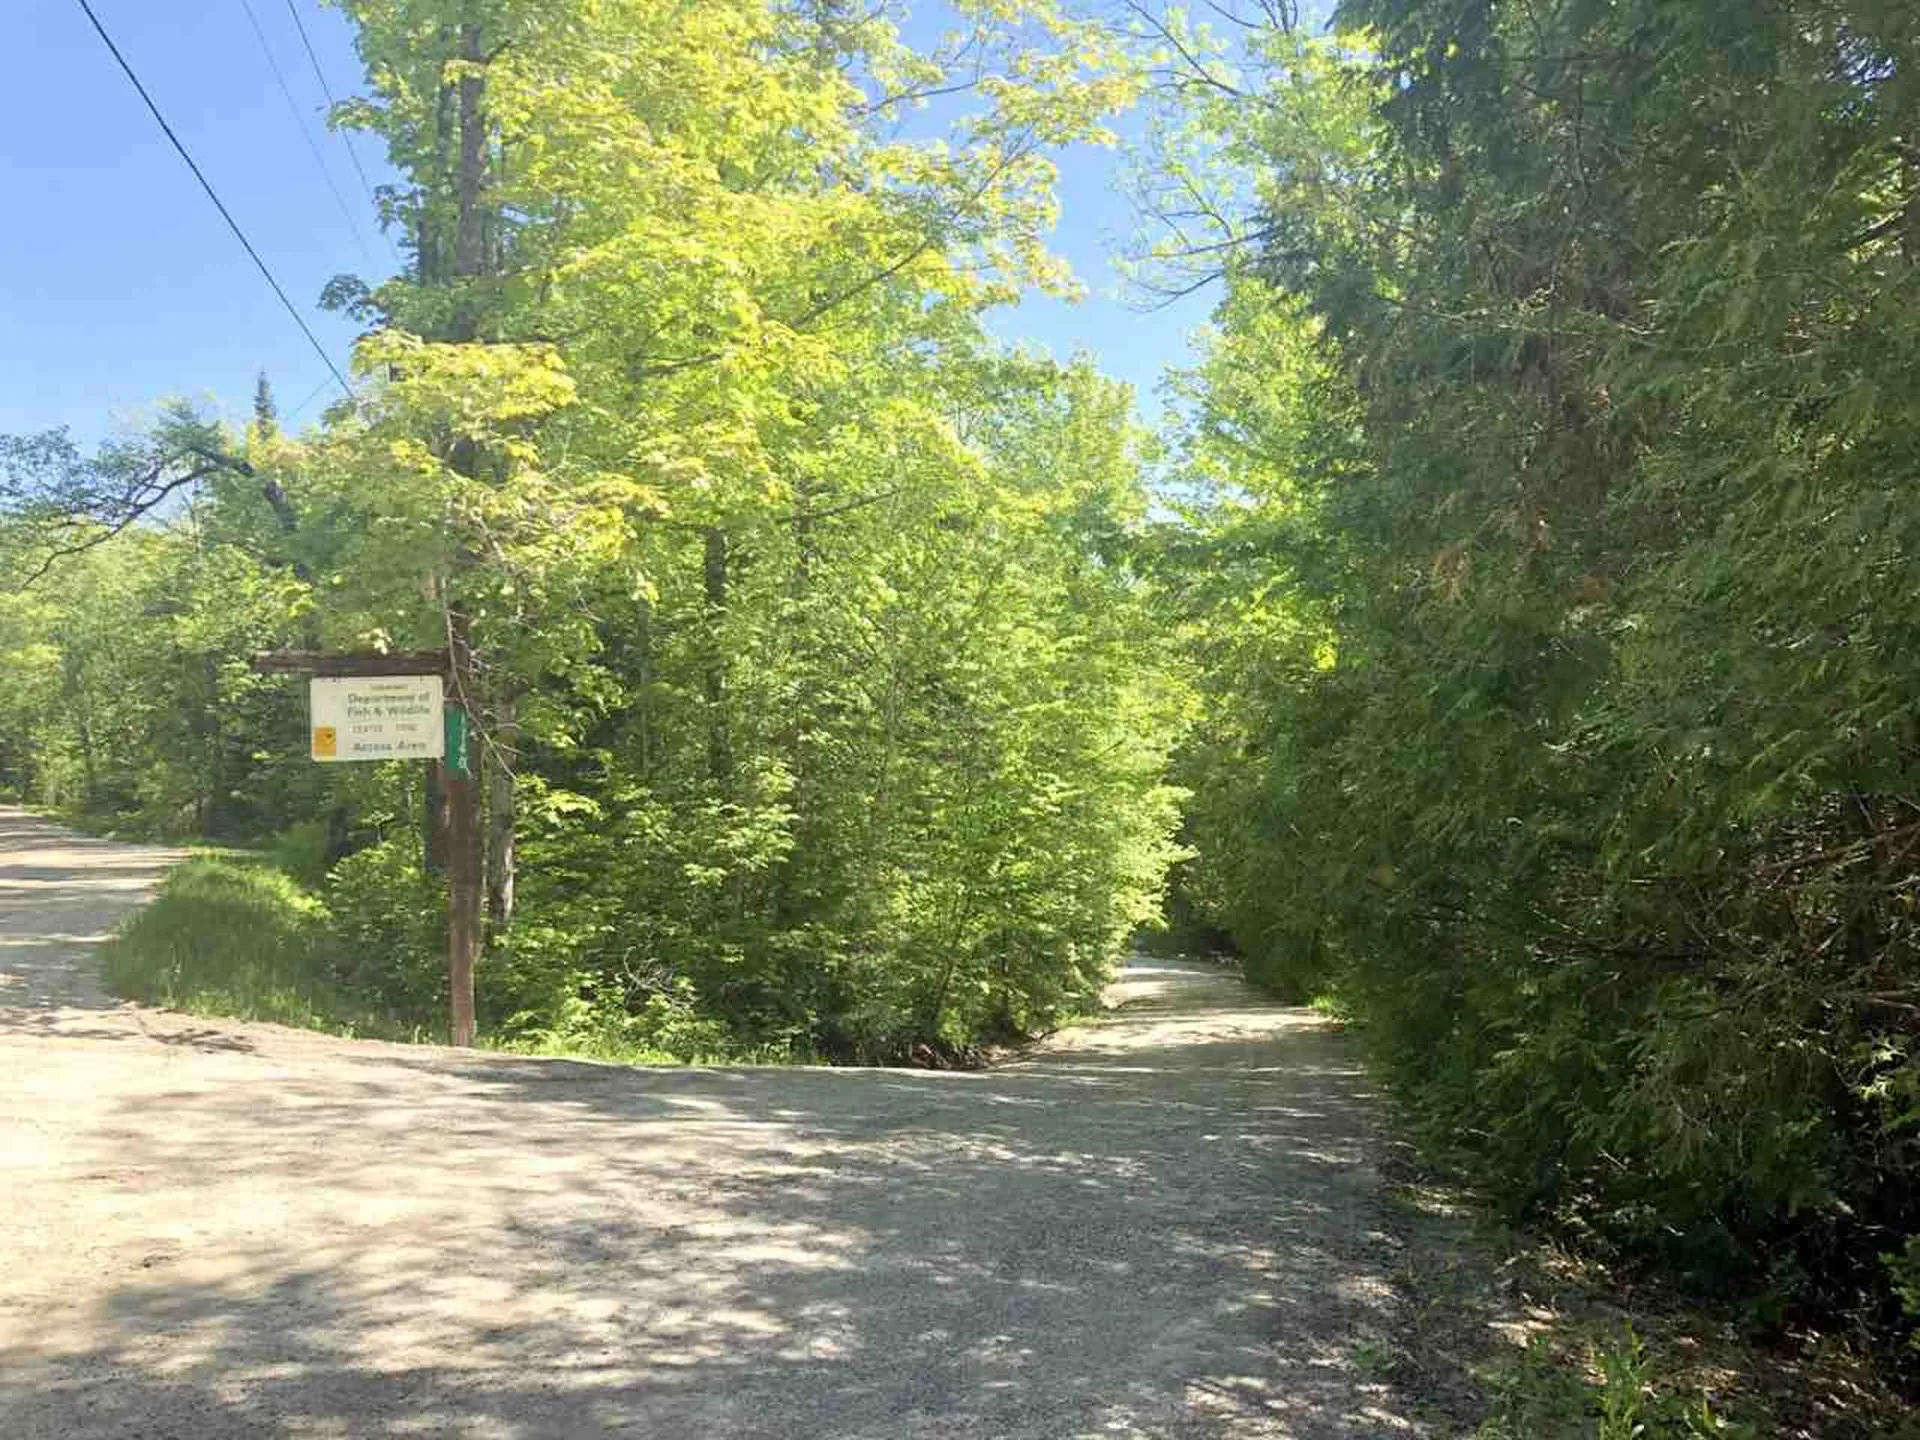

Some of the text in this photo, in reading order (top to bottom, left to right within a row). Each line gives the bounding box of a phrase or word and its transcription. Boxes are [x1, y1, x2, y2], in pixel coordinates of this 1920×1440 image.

[348, 691, 431, 705] Department of
[347, 706, 370, 718] Fish
[387, 705, 431, 717] Wildlife
[352, 739, 427, 753] Access Area
